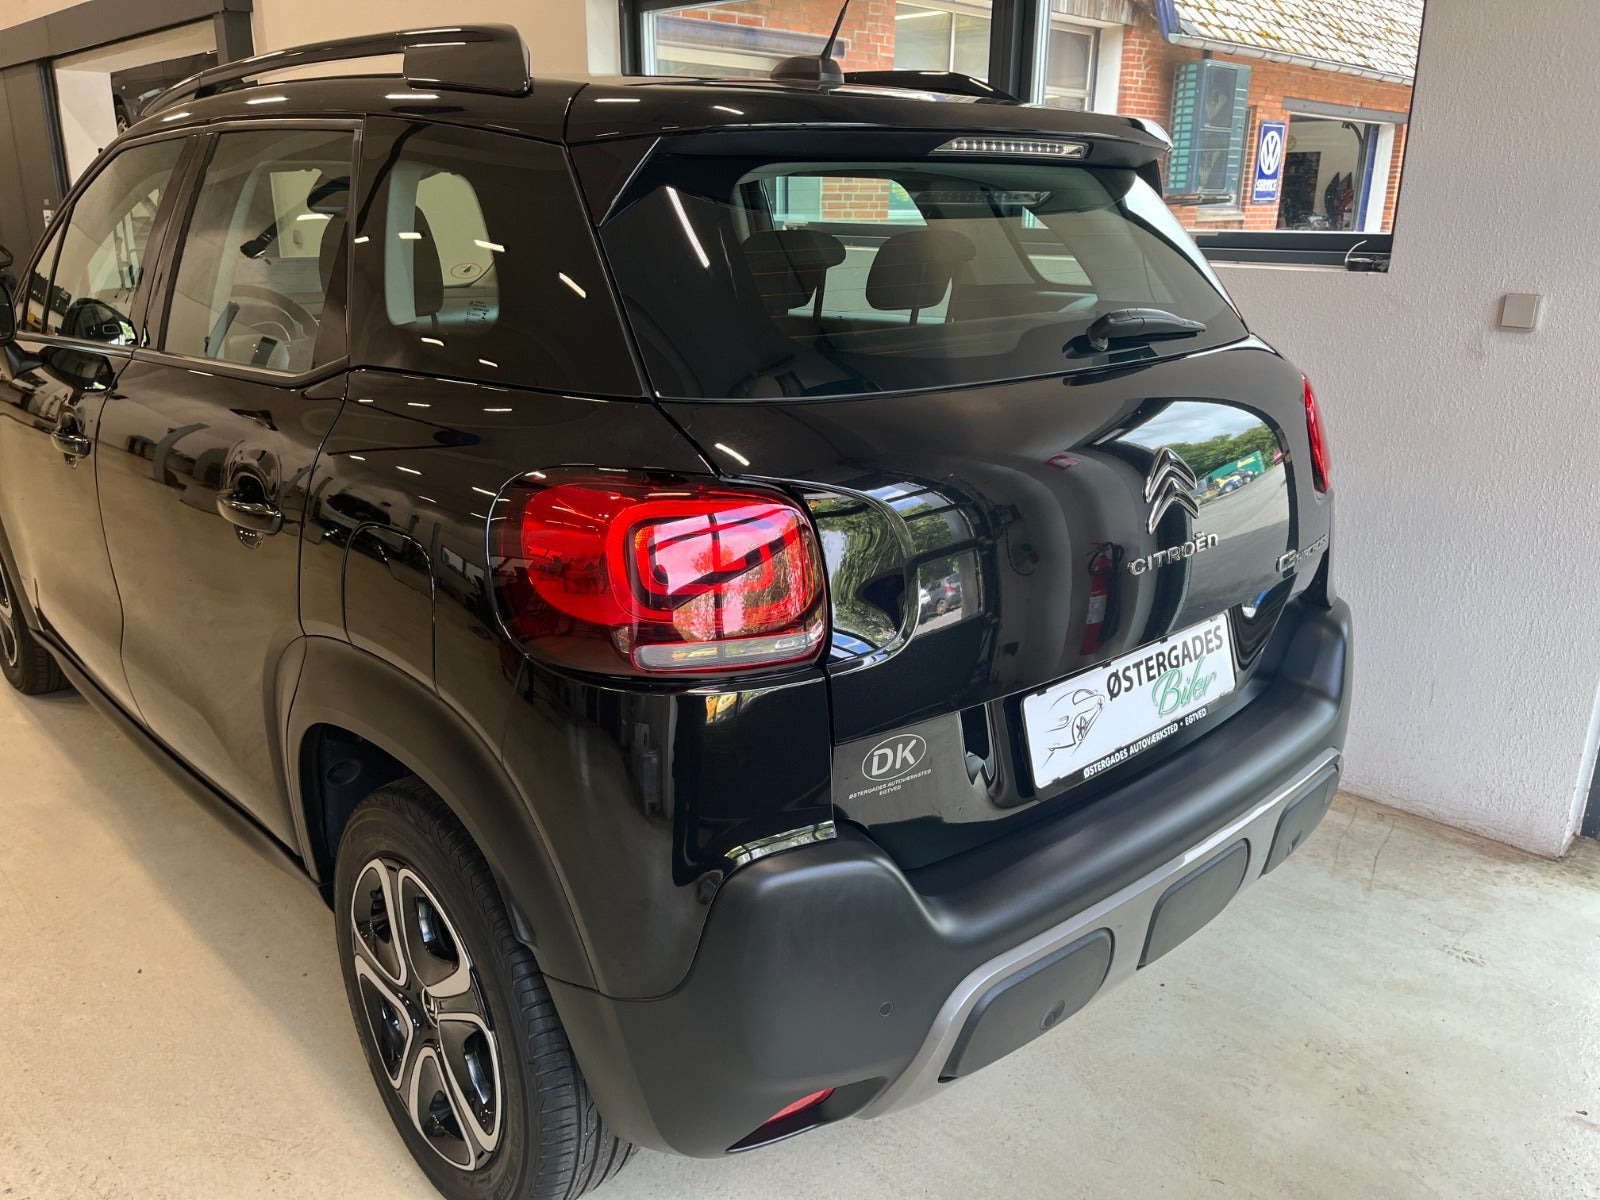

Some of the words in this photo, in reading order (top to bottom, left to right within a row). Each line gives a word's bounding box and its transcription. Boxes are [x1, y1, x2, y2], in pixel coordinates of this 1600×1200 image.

[1106, 625, 1224, 701] ØSTERGADES
[1151, 655, 1216, 716] Biler
[871, 739, 917, 776] DK
[1083, 748, 1128, 779] ØSTERGADES
[1129, 721, 1179, 756] AUTOVÆRKSTED
[1185, 707, 1207, 726] EGTVED
